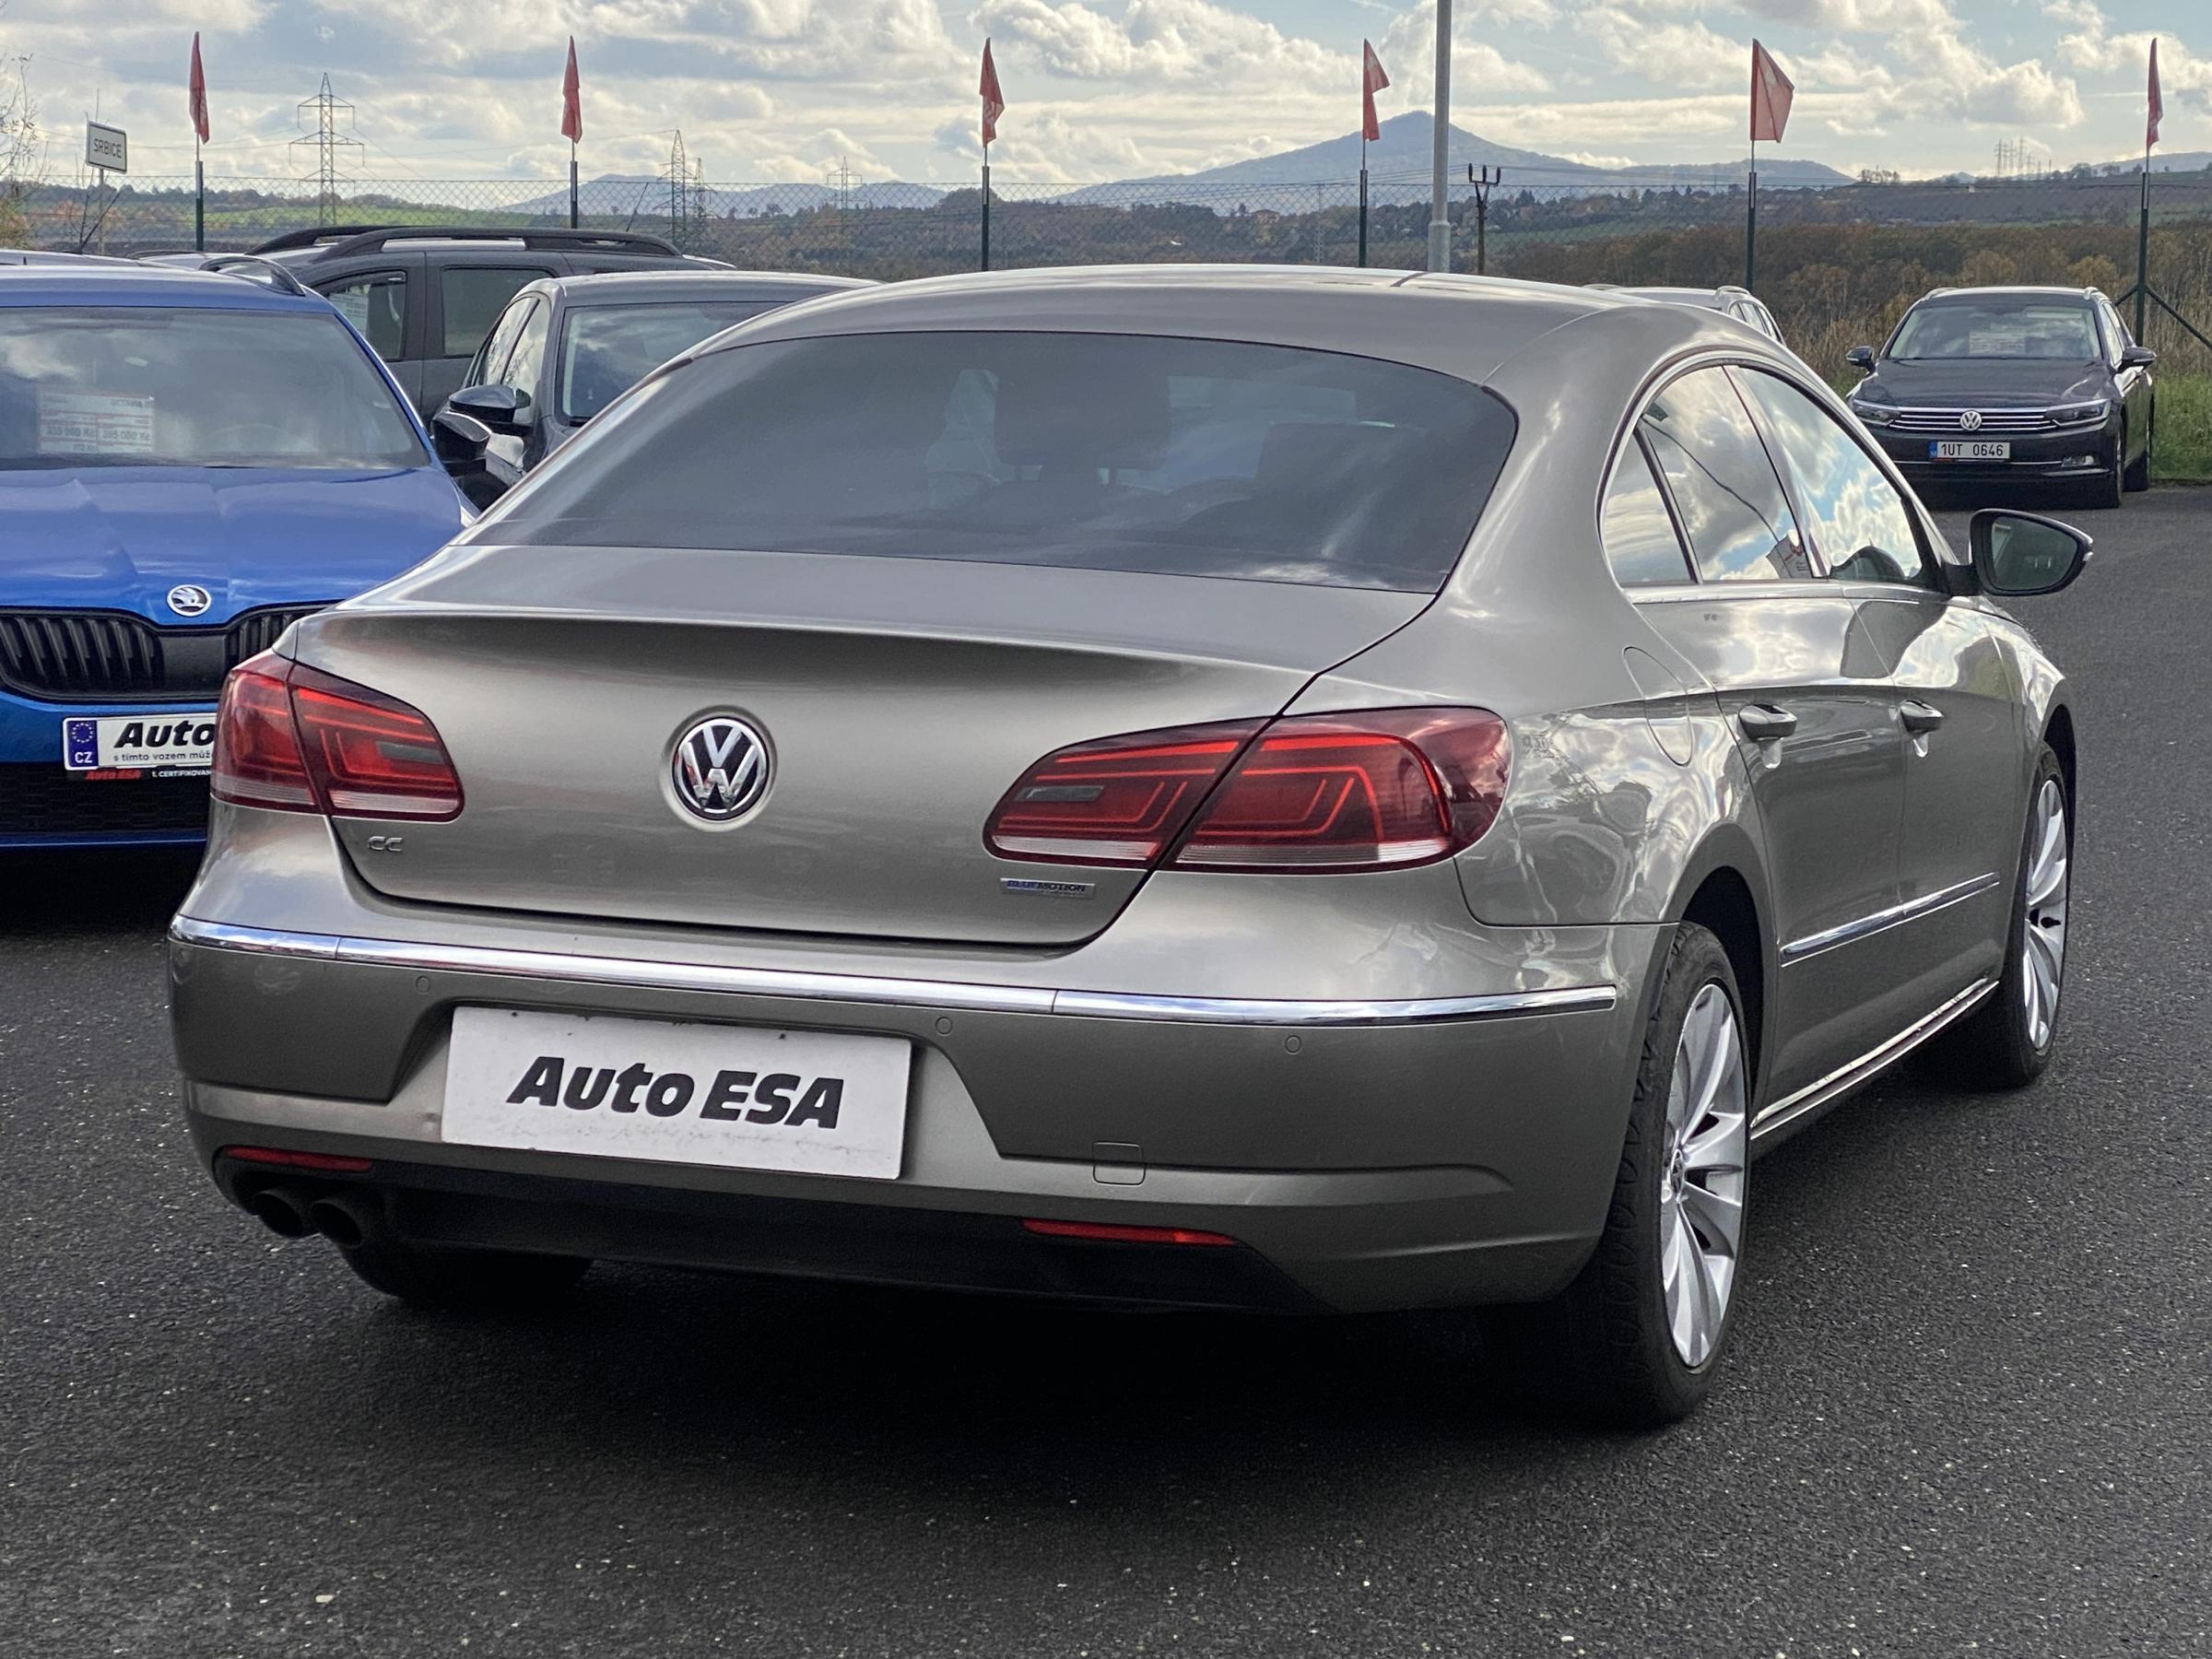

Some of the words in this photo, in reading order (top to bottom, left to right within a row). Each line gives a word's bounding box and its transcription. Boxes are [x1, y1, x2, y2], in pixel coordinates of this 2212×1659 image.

[94, 138, 122, 159] SRBICE
[1941, 443, 1963, 456] 1UT
[1972, 443, 2004, 457] 0646
[113, 720, 216, 748] Auto
[74, 751, 93, 763] CZ
[153, 752, 186, 760] vozem
[505, 1055, 695, 1118] Auto
[699, 1069, 844, 1130] ESA
